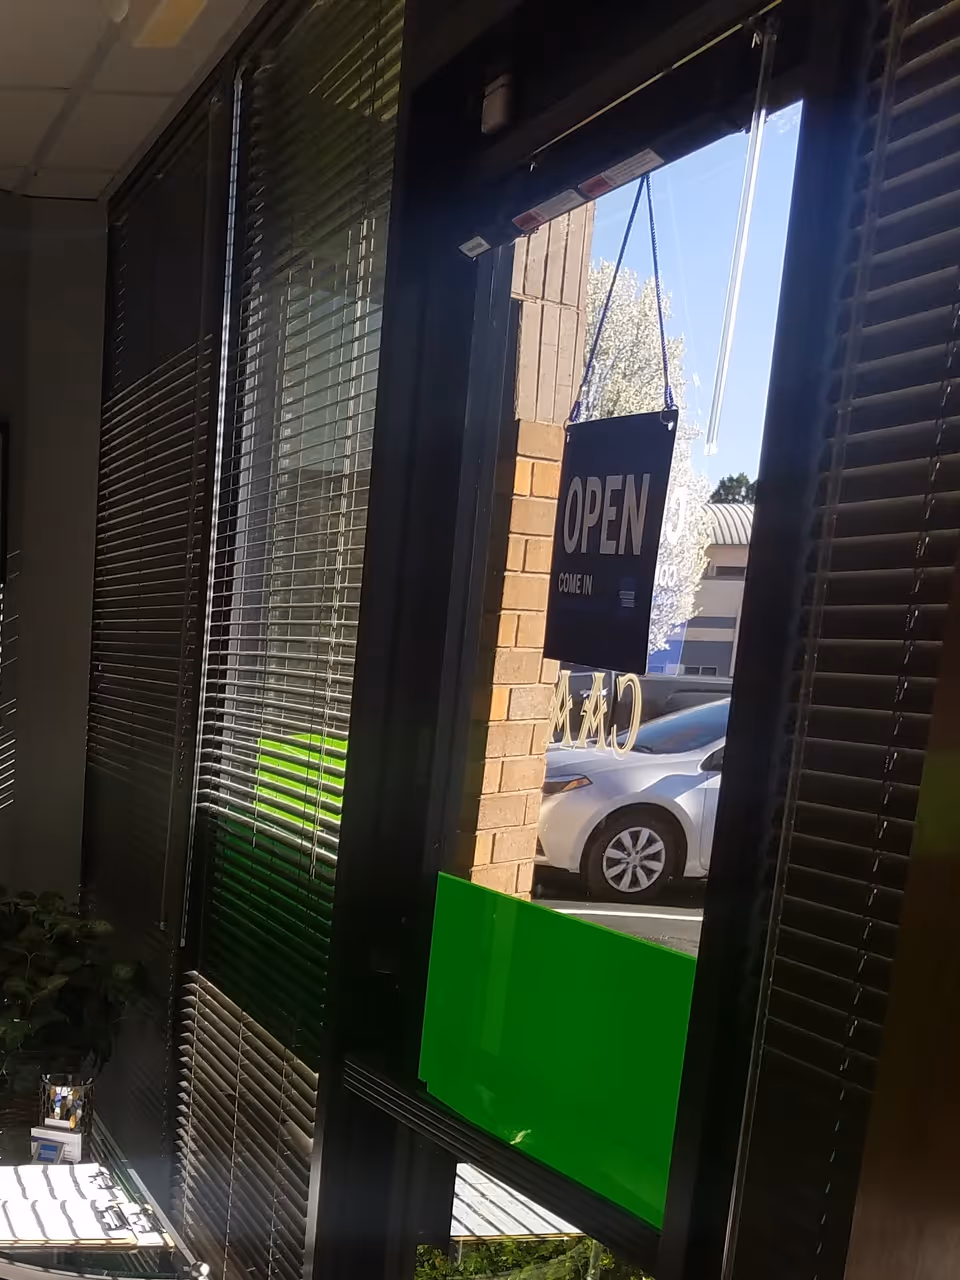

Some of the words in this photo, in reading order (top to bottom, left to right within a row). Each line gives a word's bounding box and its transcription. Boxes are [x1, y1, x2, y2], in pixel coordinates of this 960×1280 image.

[563, 473, 651, 555] OPEN
[558, 572, 582, 594] COME
[582, 574, 593, 595] IN
